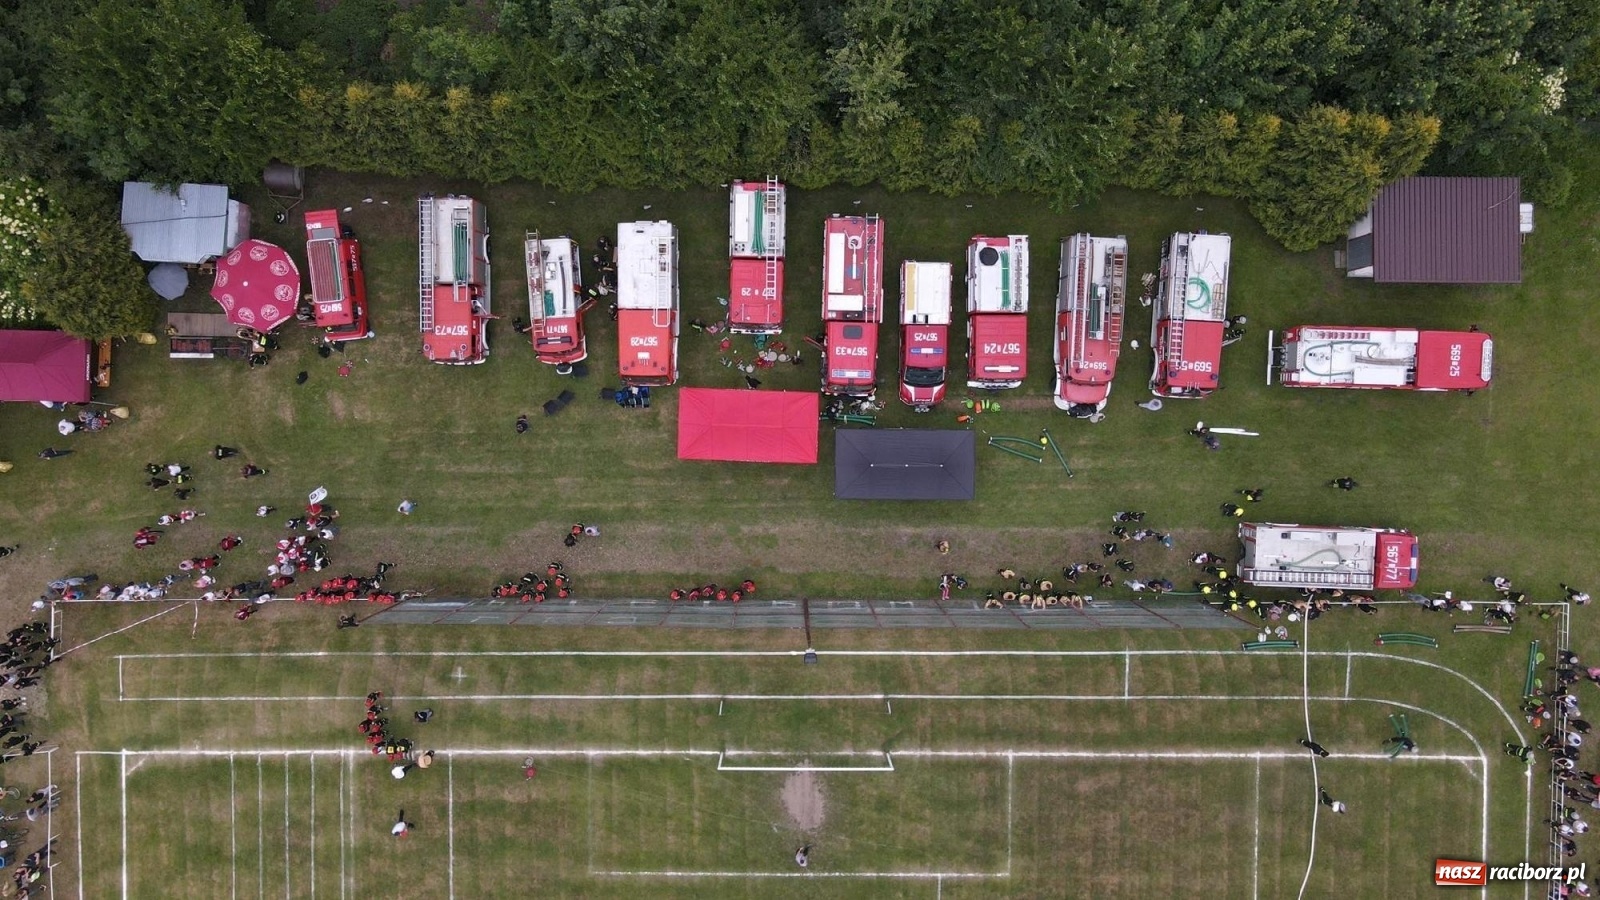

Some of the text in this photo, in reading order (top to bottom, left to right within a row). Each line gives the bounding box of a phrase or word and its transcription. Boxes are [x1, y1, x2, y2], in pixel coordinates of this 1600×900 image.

[435, 324, 469, 336] 567 73
[835, 346, 868, 356] 567 33
[984, 343, 1020, 354] 567 24
[1093, 361, 1107, 370] 569
[1449, 344, 1461, 377] 569 25
[1194, 361, 1212, 372] 569
[1385, 545, 1399, 580] 567 77
